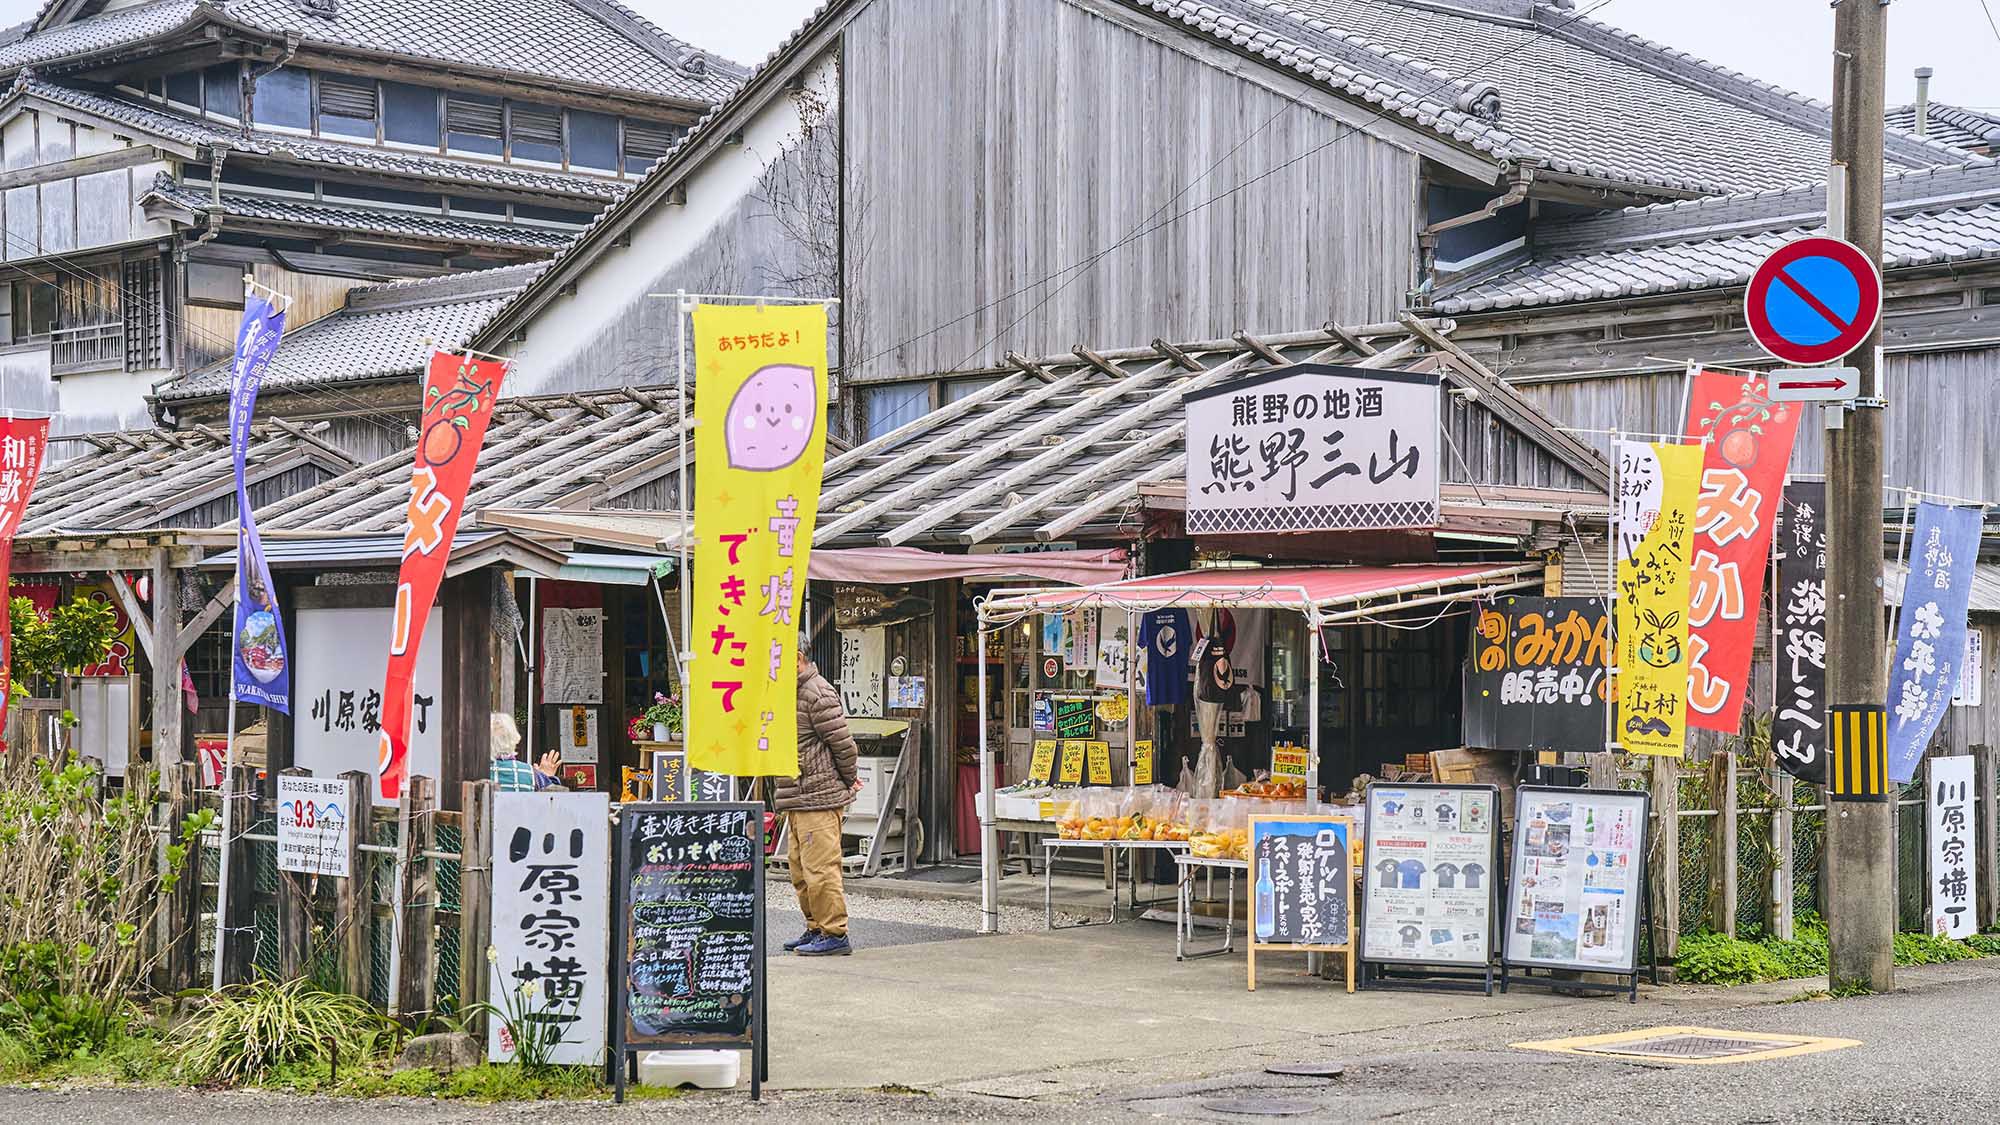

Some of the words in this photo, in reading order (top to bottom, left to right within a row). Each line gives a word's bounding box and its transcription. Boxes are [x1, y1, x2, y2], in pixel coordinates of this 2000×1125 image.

[1232, 387, 1384, 427] 熊野の地酒
[1200, 427, 1420, 502] 熊野三山
[1620, 454, 1631, 521] うま!
[1630, 456, 1652, 522] にが!
[710, 527, 759, 714] できたて
[1478, 608, 1507, 672] 旬の
[1514, 609, 1619, 668] みかん
[311, 688, 434, 734] 川原家丁
[1501, 667, 1602, 706] 販売中!
[294, 799, 315, 829] 9.3
[1274, 836, 1294, 914] スペースポート
[1314, 829, 1338, 902] ロケット
[1937, 780, 1968, 929] 川原家横丁
[1297, 842, 1322, 940] 発射基地完成
